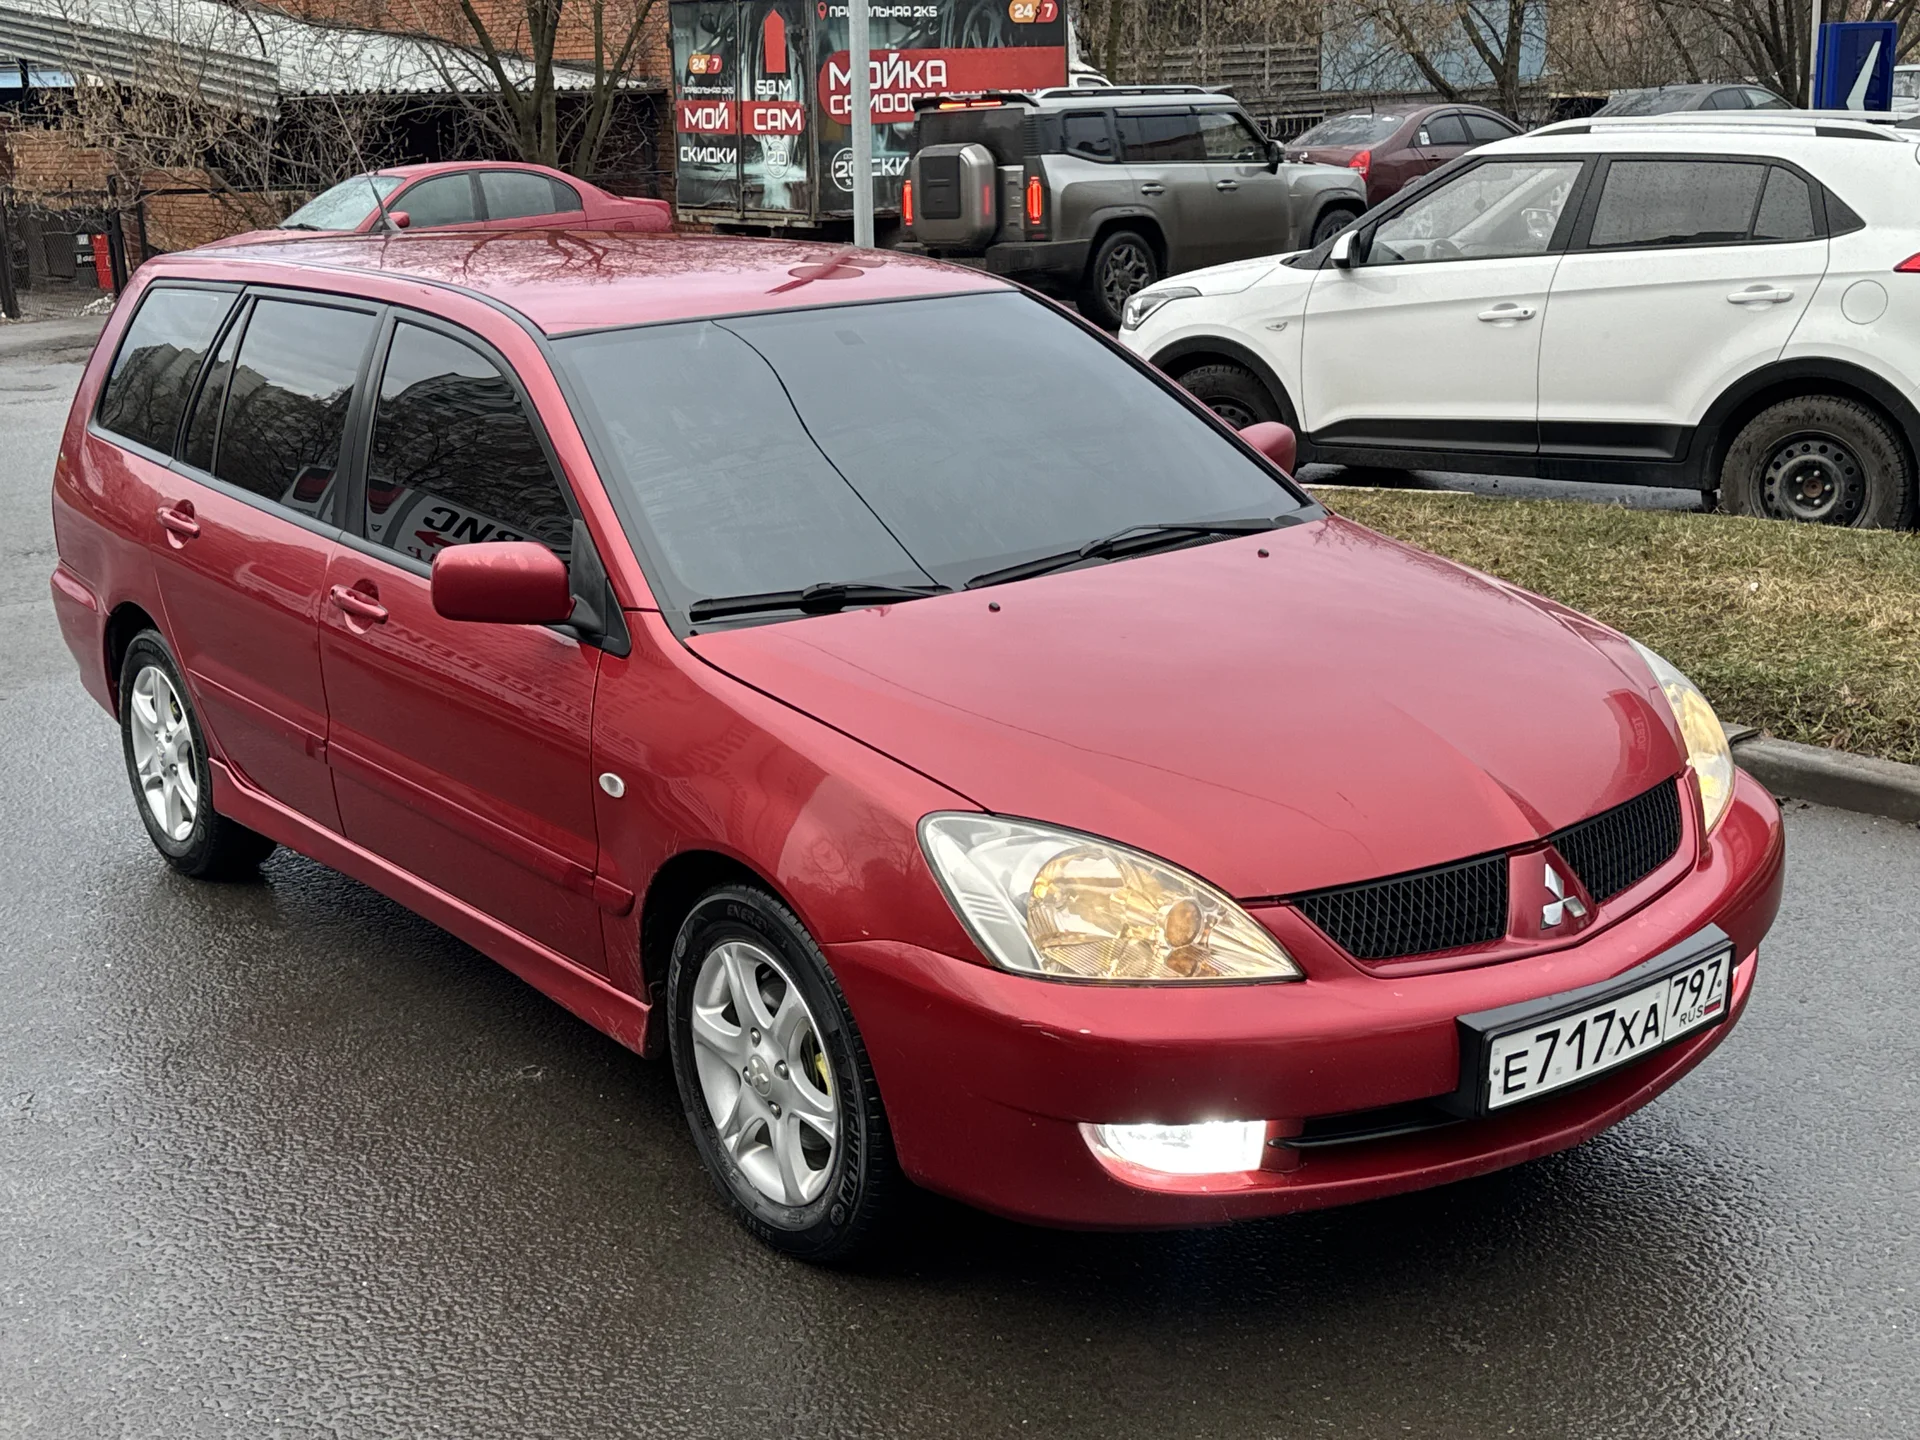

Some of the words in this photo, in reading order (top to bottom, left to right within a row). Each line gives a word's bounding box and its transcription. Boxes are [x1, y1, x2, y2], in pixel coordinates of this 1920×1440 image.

[829, 5, 911, 17] ПРЛЬНАЯ
[828, 53, 947, 91] МОЙКА
[684, 102, 729, 130] МОЙ
[753, 108, 802, 131] САМ
[680, 146, 737, 163] СКИДКИ
[1672, 958, 1722, 1017] 797
[1679, 1003, 1704, 1028] RUS
